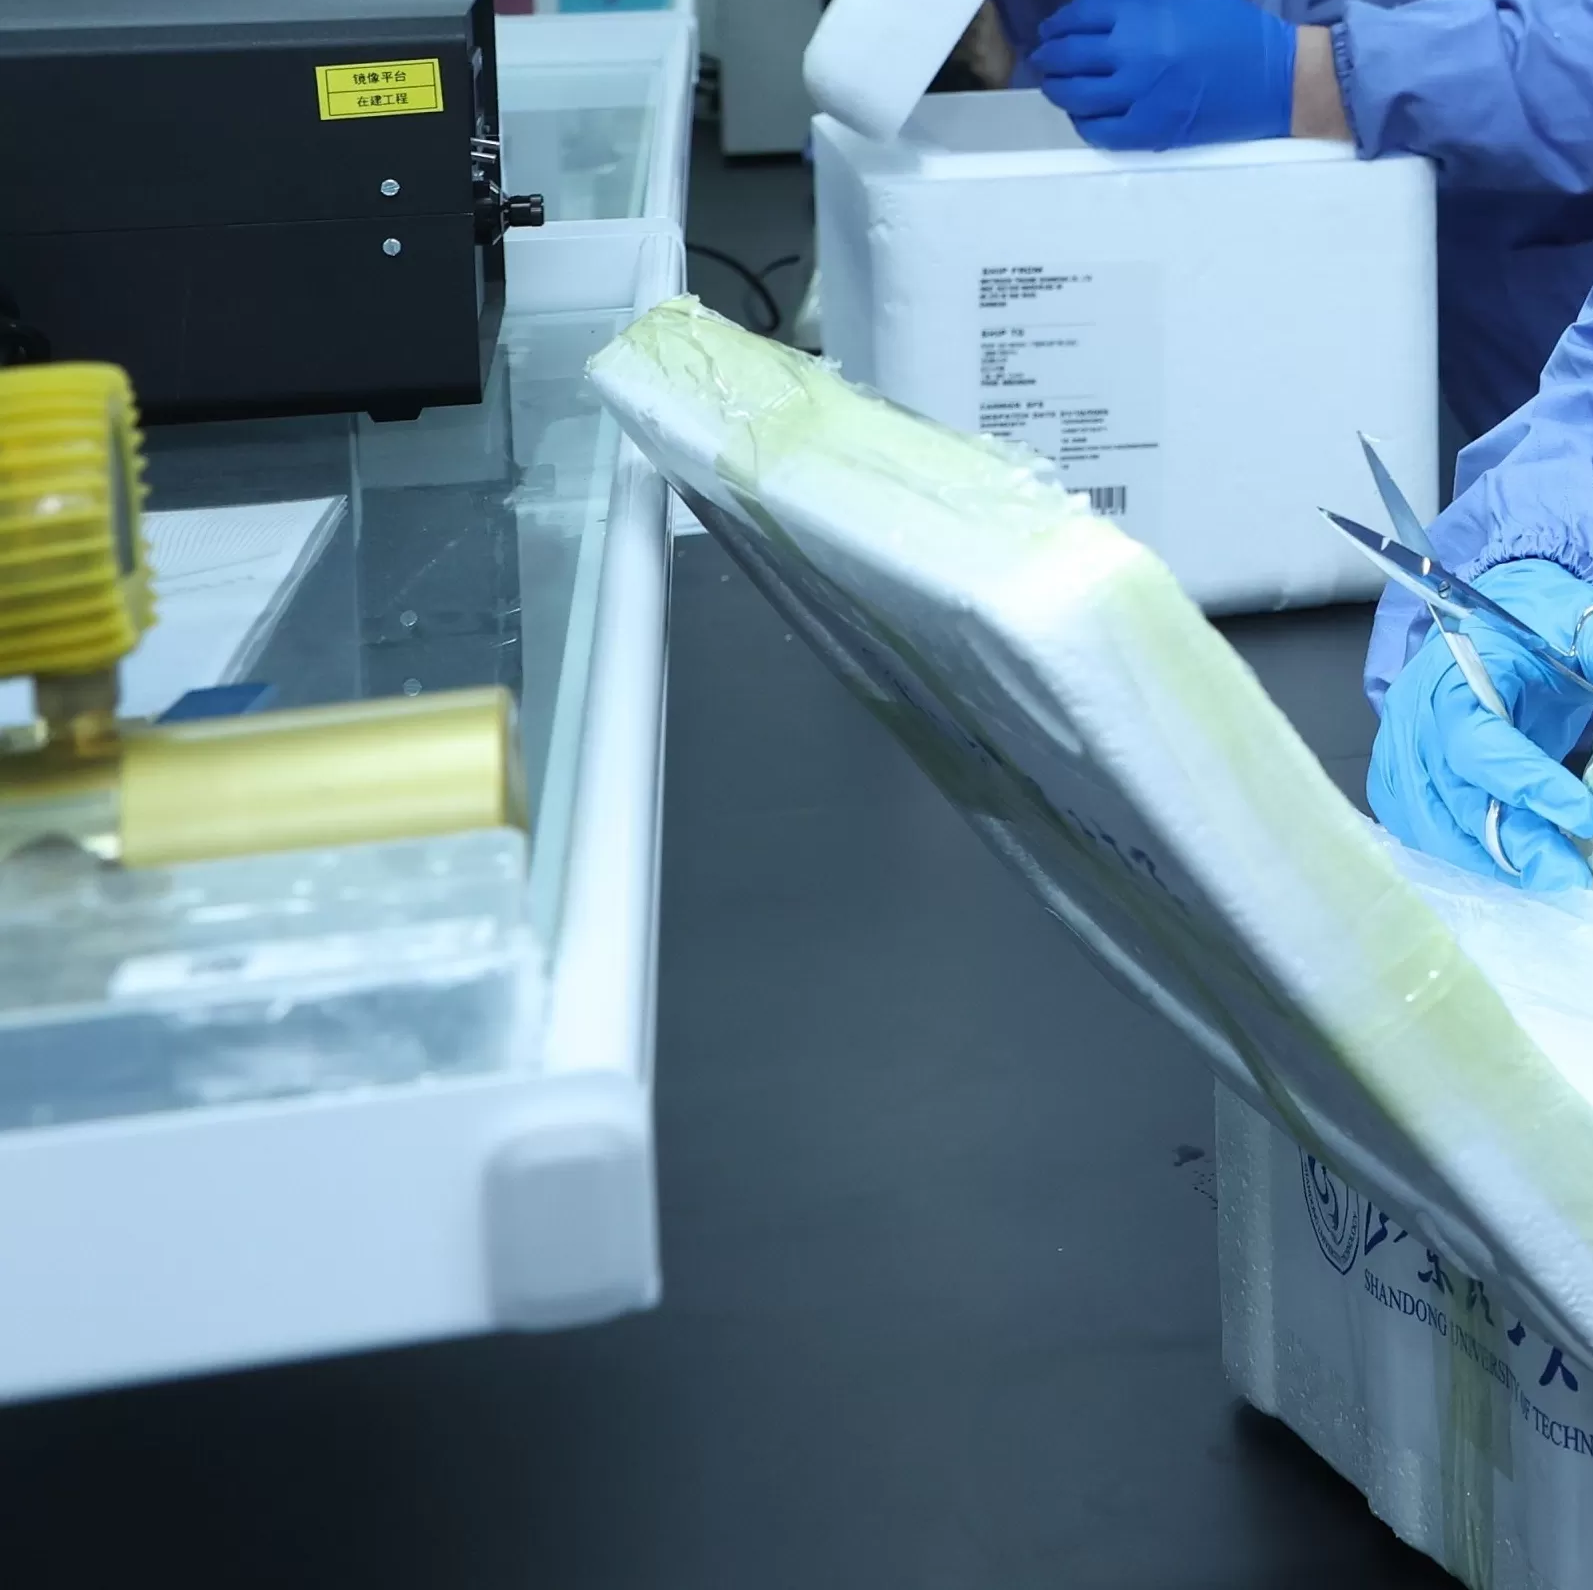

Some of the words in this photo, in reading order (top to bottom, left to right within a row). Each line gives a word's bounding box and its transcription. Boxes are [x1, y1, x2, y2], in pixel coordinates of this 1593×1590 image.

[352, 70, 407, 85] 镜像平台
[357, 93, 409, 108] 在建工程
[1364, 1268, 1448, 1337] SHANDONG
[1450, 1319, 1520, 1402] UNIVERSITY
[1520, 1389, 1531, 1420] OF
